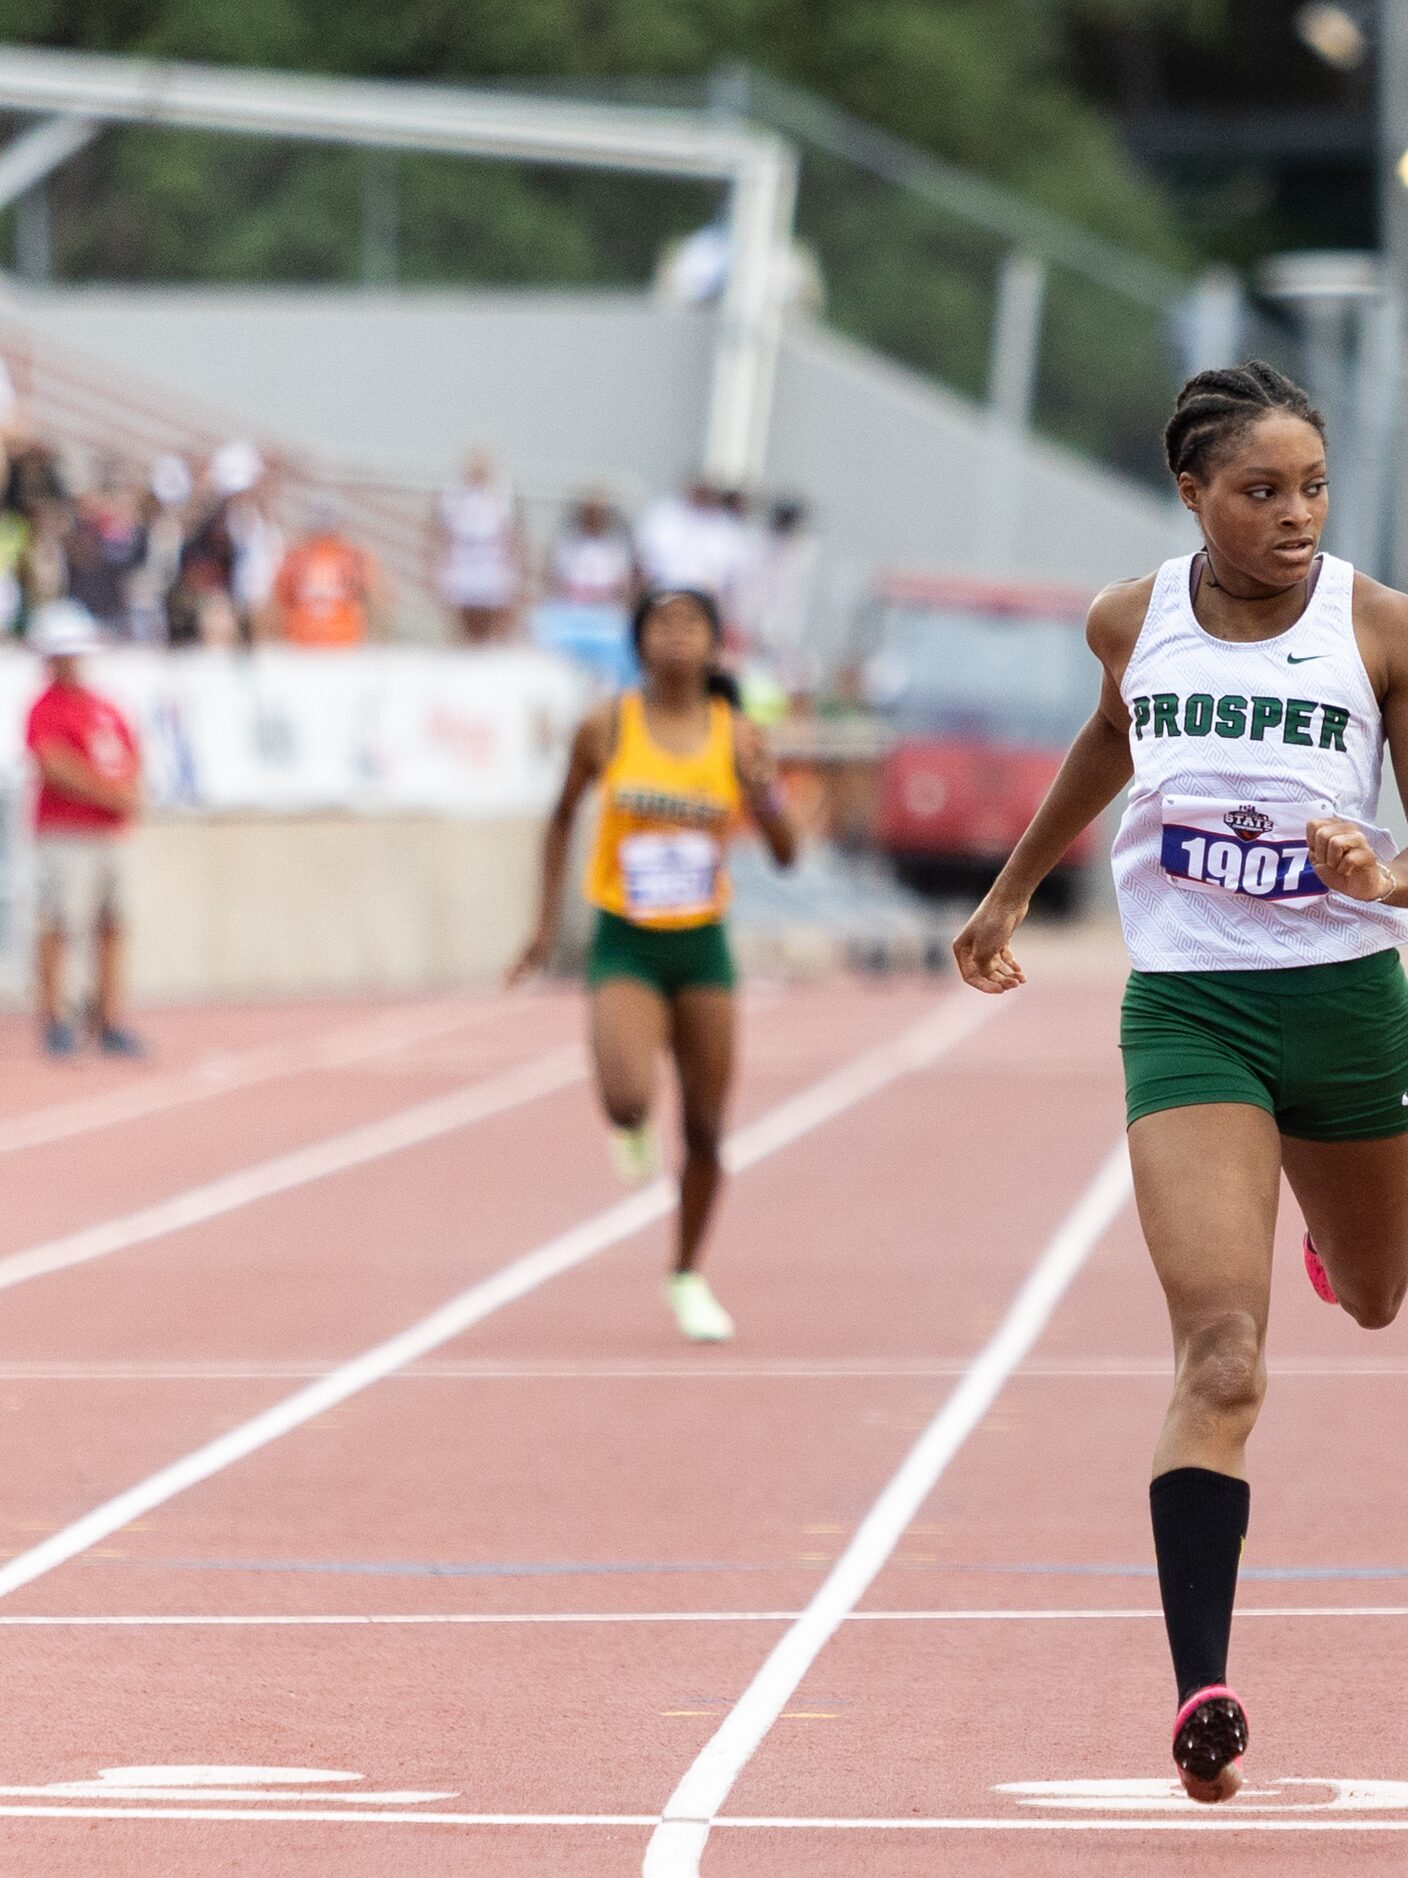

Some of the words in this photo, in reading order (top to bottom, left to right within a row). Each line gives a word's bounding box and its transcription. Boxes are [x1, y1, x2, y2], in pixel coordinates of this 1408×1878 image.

[1132, 693, 1351, 752] PROSPER
[1225, 813, 1272, 829] STATE
[1181, 837, 1310, 896] 1907
